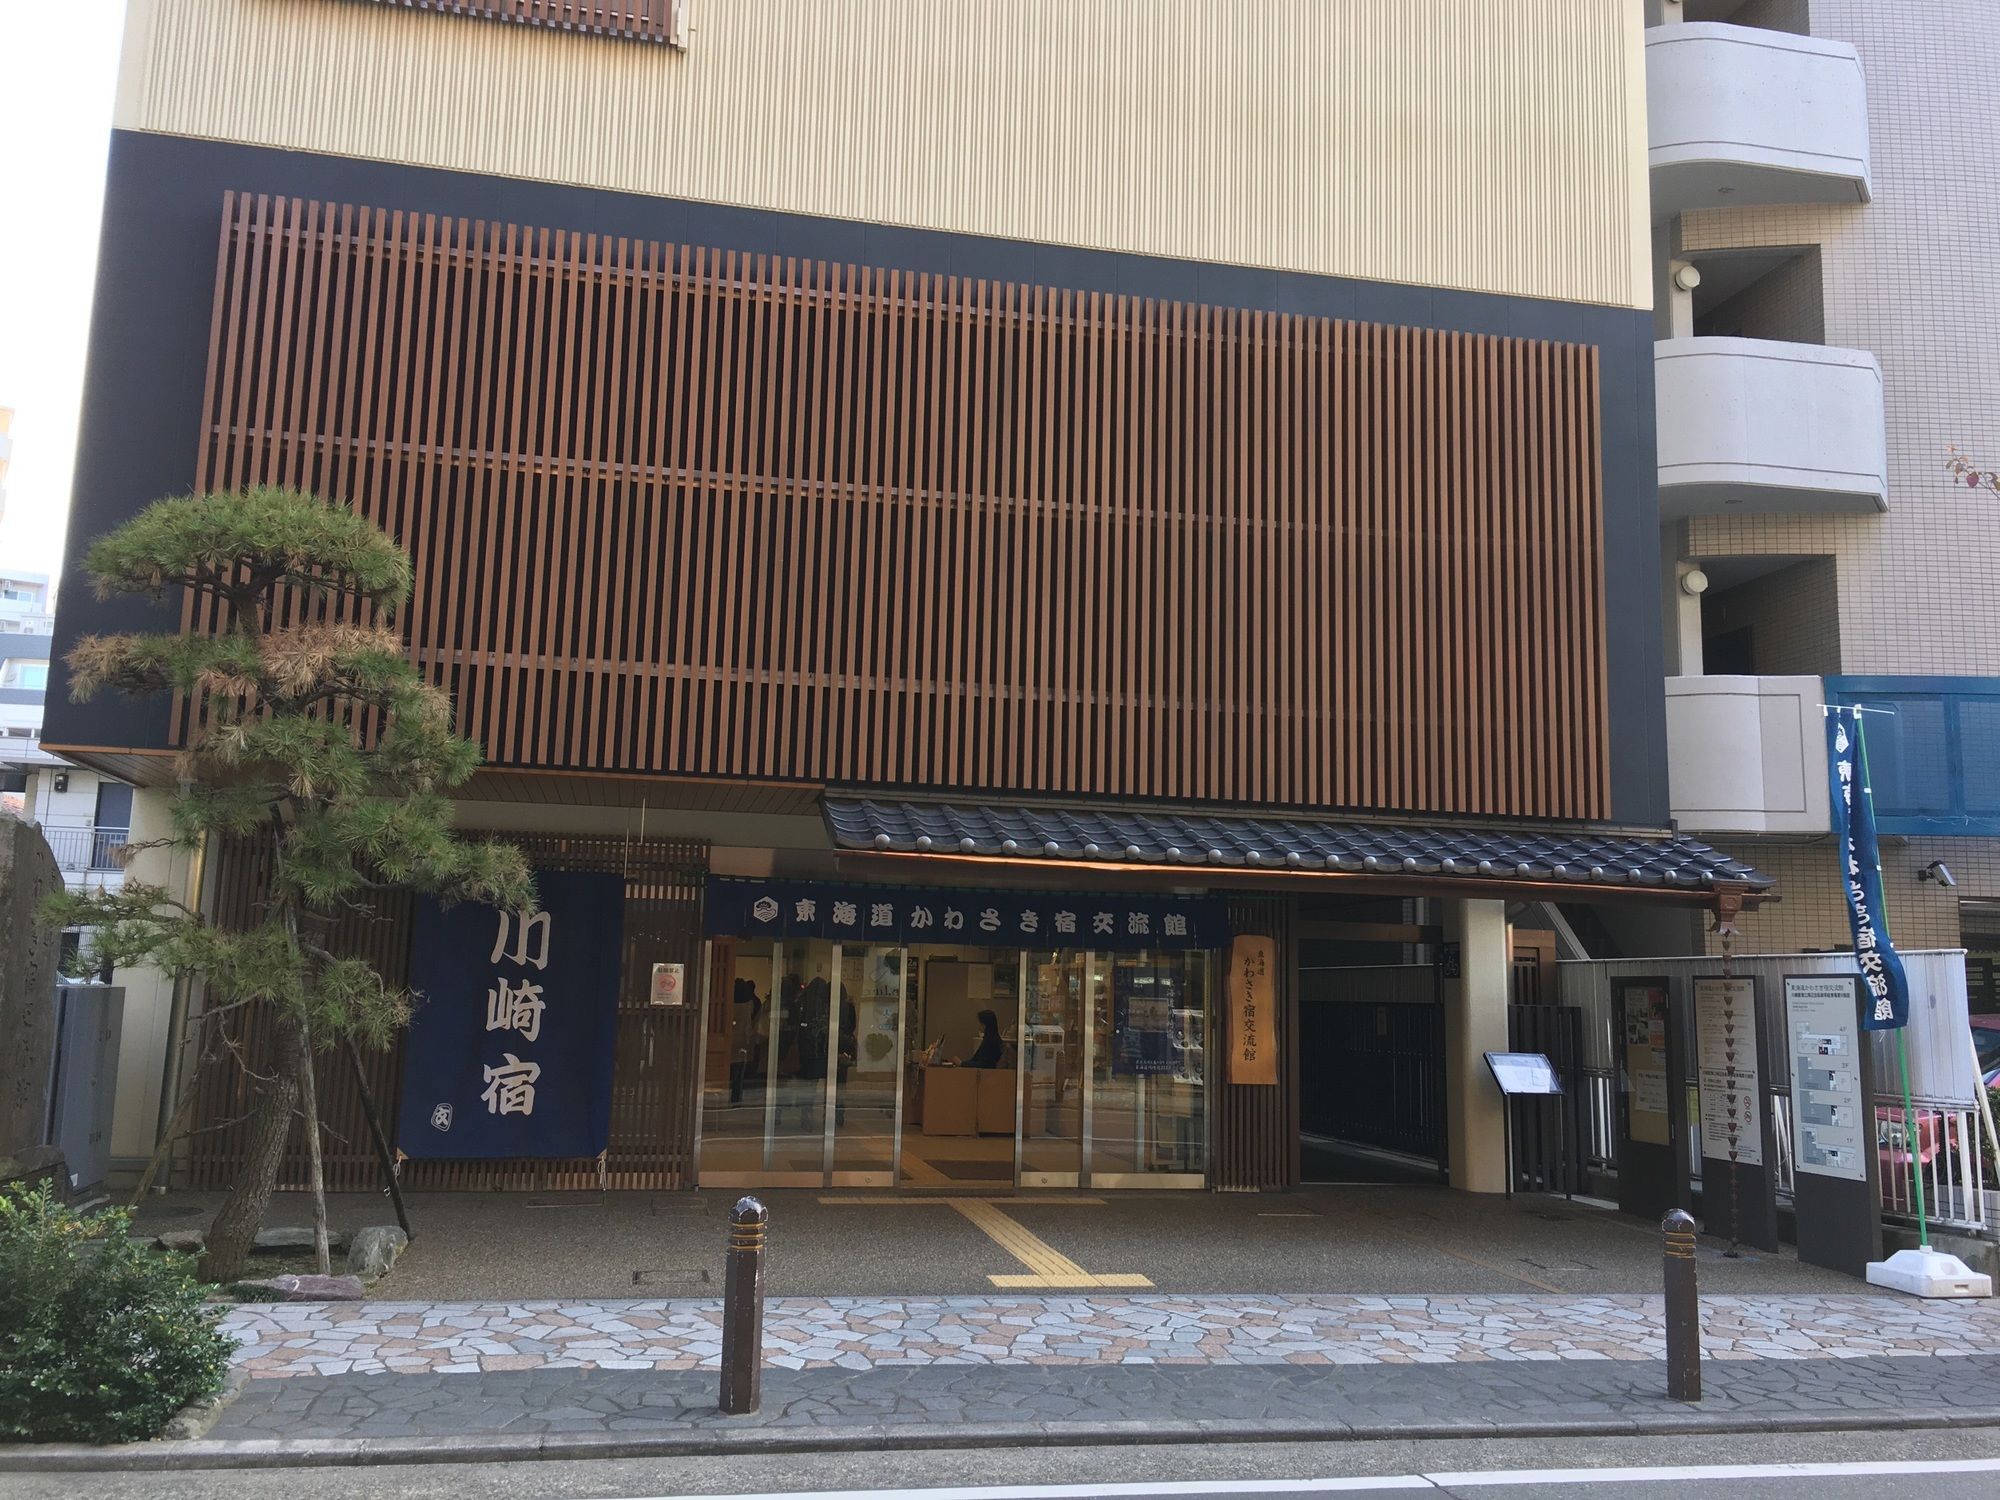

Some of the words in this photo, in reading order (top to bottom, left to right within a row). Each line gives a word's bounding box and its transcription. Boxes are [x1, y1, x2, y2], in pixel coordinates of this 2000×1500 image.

[795, 898, 1187, 936] 東海道かわさき宿交流館
[481, 910, 551, 1115] 川崎宿
[1242, 957, 1257, 1061] かわさき宿交流館
